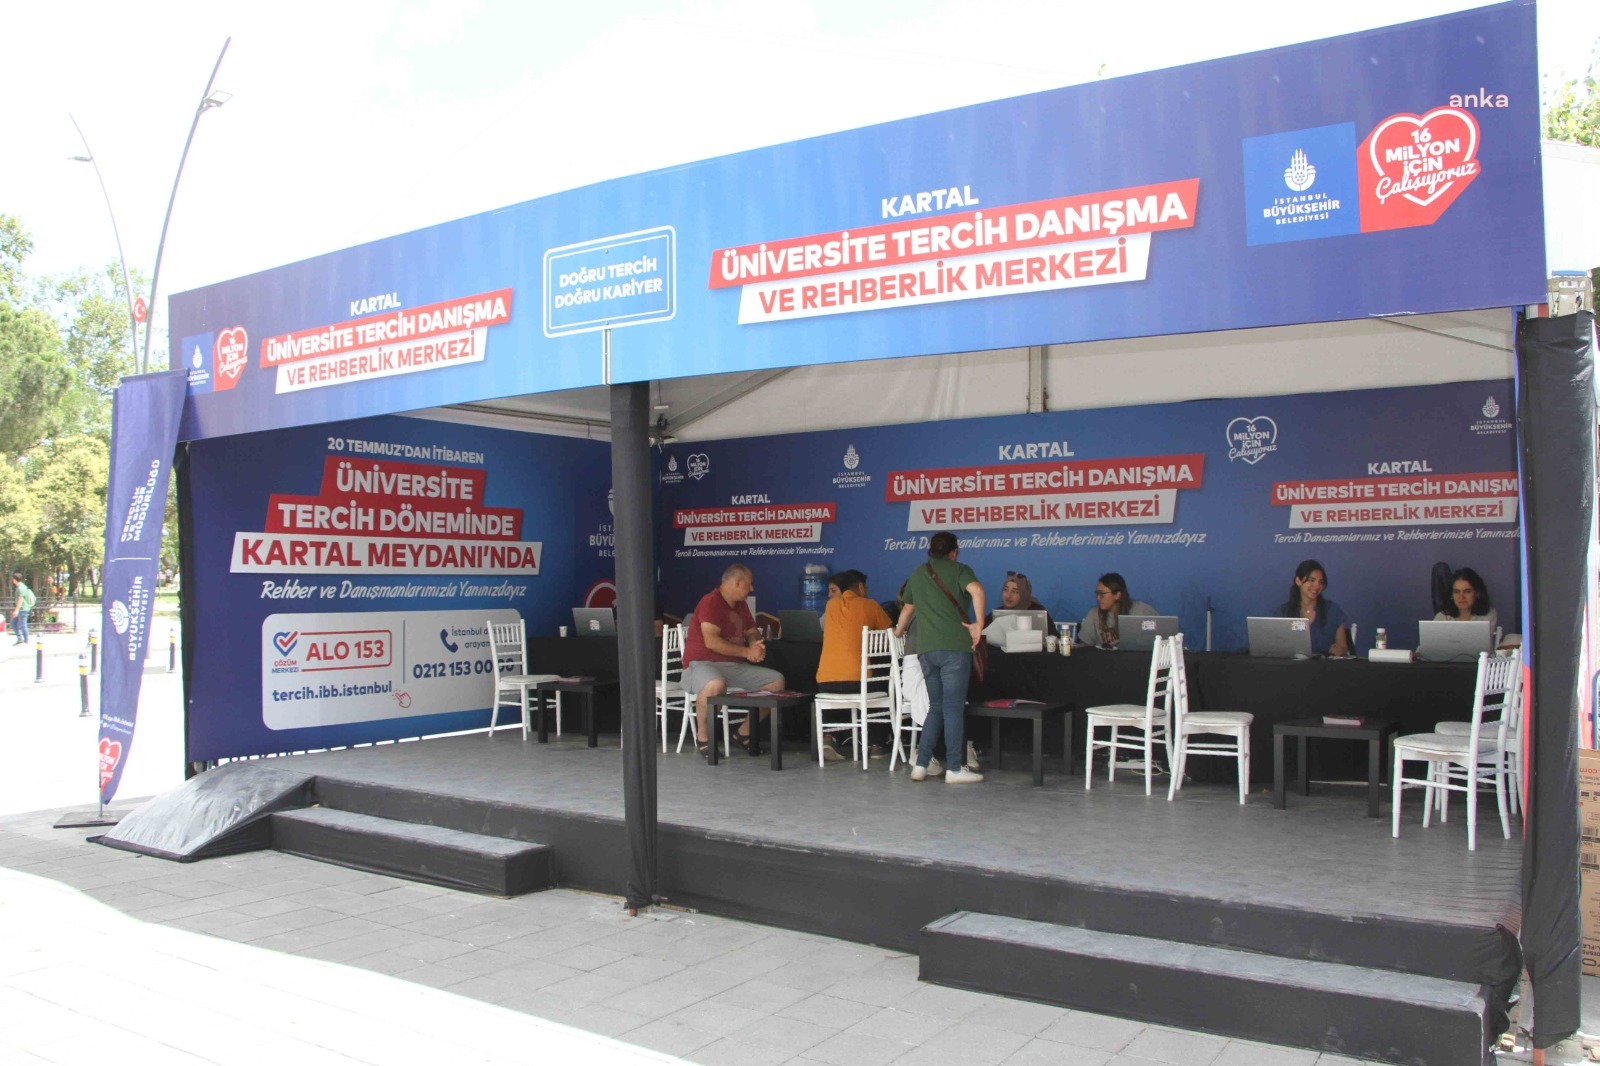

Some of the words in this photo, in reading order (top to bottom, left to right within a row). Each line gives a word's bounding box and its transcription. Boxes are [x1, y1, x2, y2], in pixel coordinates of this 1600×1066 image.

[1411, 128, 1432, 144] 16
[1376, 163, 1477, 205] Çalışıyoruz
[881, 185, 979, 219] KARTAL
[1263, 199, 1340, 218] BÜYÜKŞEHİR
[1274, 193, 1328, 205] İSTANBUL
[1275, 212, 1329, 225] BELEDİYESİ
[721, 231, 887, 281] ÜNİVERSİTE
[892, 211, 1008, 258] TERCİH
[1015, 192, 1188, 241] DANIŞMA
[560, 266, 606, 288] DOĞRU
[608, 255, 657, 278] TERCİH
[759, 288, 795, 314] VE
[802, 260, 968, 310] REHBERLİK
[975, 237, 1128, 290] MERKEZİ
[350, 292, 402, 317] KARTAL
[555, 287, 601, 309] DOĞRU
[603, 277, 663, 300] KARİYER
[267, 325, 354, 362] ÜNİVERSİTE
[355, 312, 415, 345] TERCİH
[418, 297, 507, 332] DANIŞMA
[286, 366, 305, 386] VE
[309, 346, 394, 383] REHBERLİK
[398, 330, 475, 369] MERKEZİ
[1246, 424, 1257, 433] 16
[327, 437, 345, 451] 20
[347, 439, 431, 459] TEMMUZ'DAN
[433, 444, 484, 465] İTİBAREN
[999, 441, 1075, 461] KARTAL
[1367, 460, 1432, 475] KARTAL
[336, 462, 473, 500] ÜNİVERSİTE
[893, 470, 1006, 496] ÜNİVERSİTE
[1009, 466, 1083, 490] TERCİH
[1088, 464, 1194, 487] DANIŞMA
[1276, 481, 1374, 501] ÜNİVERSİTE
[1378, 478, 1441, 498] TERCİH
[1445, 478, 1519, 495] DANIŞM
[731, 494, 771, 505] KARTAL
[921, 508, 947, 524] VE
[951, 498, 1061, 523] REHBERLİK
[1065, 494, 1160, 519] MERKEZİ
[278, 500, 374, 531] TERCİH
[380, 503, 514, 536] DÖNEMİNDE
[677, 510, 736, 525] ÜNİVERSİTE
[738, 507, 776, 523] TERCİH
[778, 507, 831, 522] DANIŞMA
[1300, 510, 1322, 524] VE
[1326, 502, 1420, 522] REHBERLİK
[1424, 500, 1504, 519] MERKEZİ
[691, 532, 705, 542] VE
[706, 527, 763, 541] REHBERLİK
[765, 525, 813, 540] MERKEZİ
[884, 536, 916, 551] Tercih
[1014, 538, 1028, 547] ve
[1031, 531, 1125, 547] Rehberlerimizle
[1127, 528, 1207, 547] Yanınızdayız
[1273, 532, 1302, 544] Tercih
[1383, 532, 1395, 541] ve
[1397, 529, 1474, 541] Rehberlerimizle
[242, 538, 361, 566] KARTAL
[368, 543, 537, 569] MEYDANI'NDA
[260, 579, 317, 600] Rehber
[319, 585, 336, 599] ve
[339, 579, 455, 600] Danışmanlarımızla
[459, 579, 528, 601] Yanınızdayız
[128, 576, 143, 661] BÜYÜKŞEHİR
[451, 626, 482, 637] İstanbul
[305, 641, 350, 662] ALO
[354, 640, 385, 659] 153
[413, 661, 446, 679] 0212
[449, 661, 471, 676] 153
[474, 660, 494, 675] 00
[272, 681, 392, 702] tercih.ibb.istanbul
